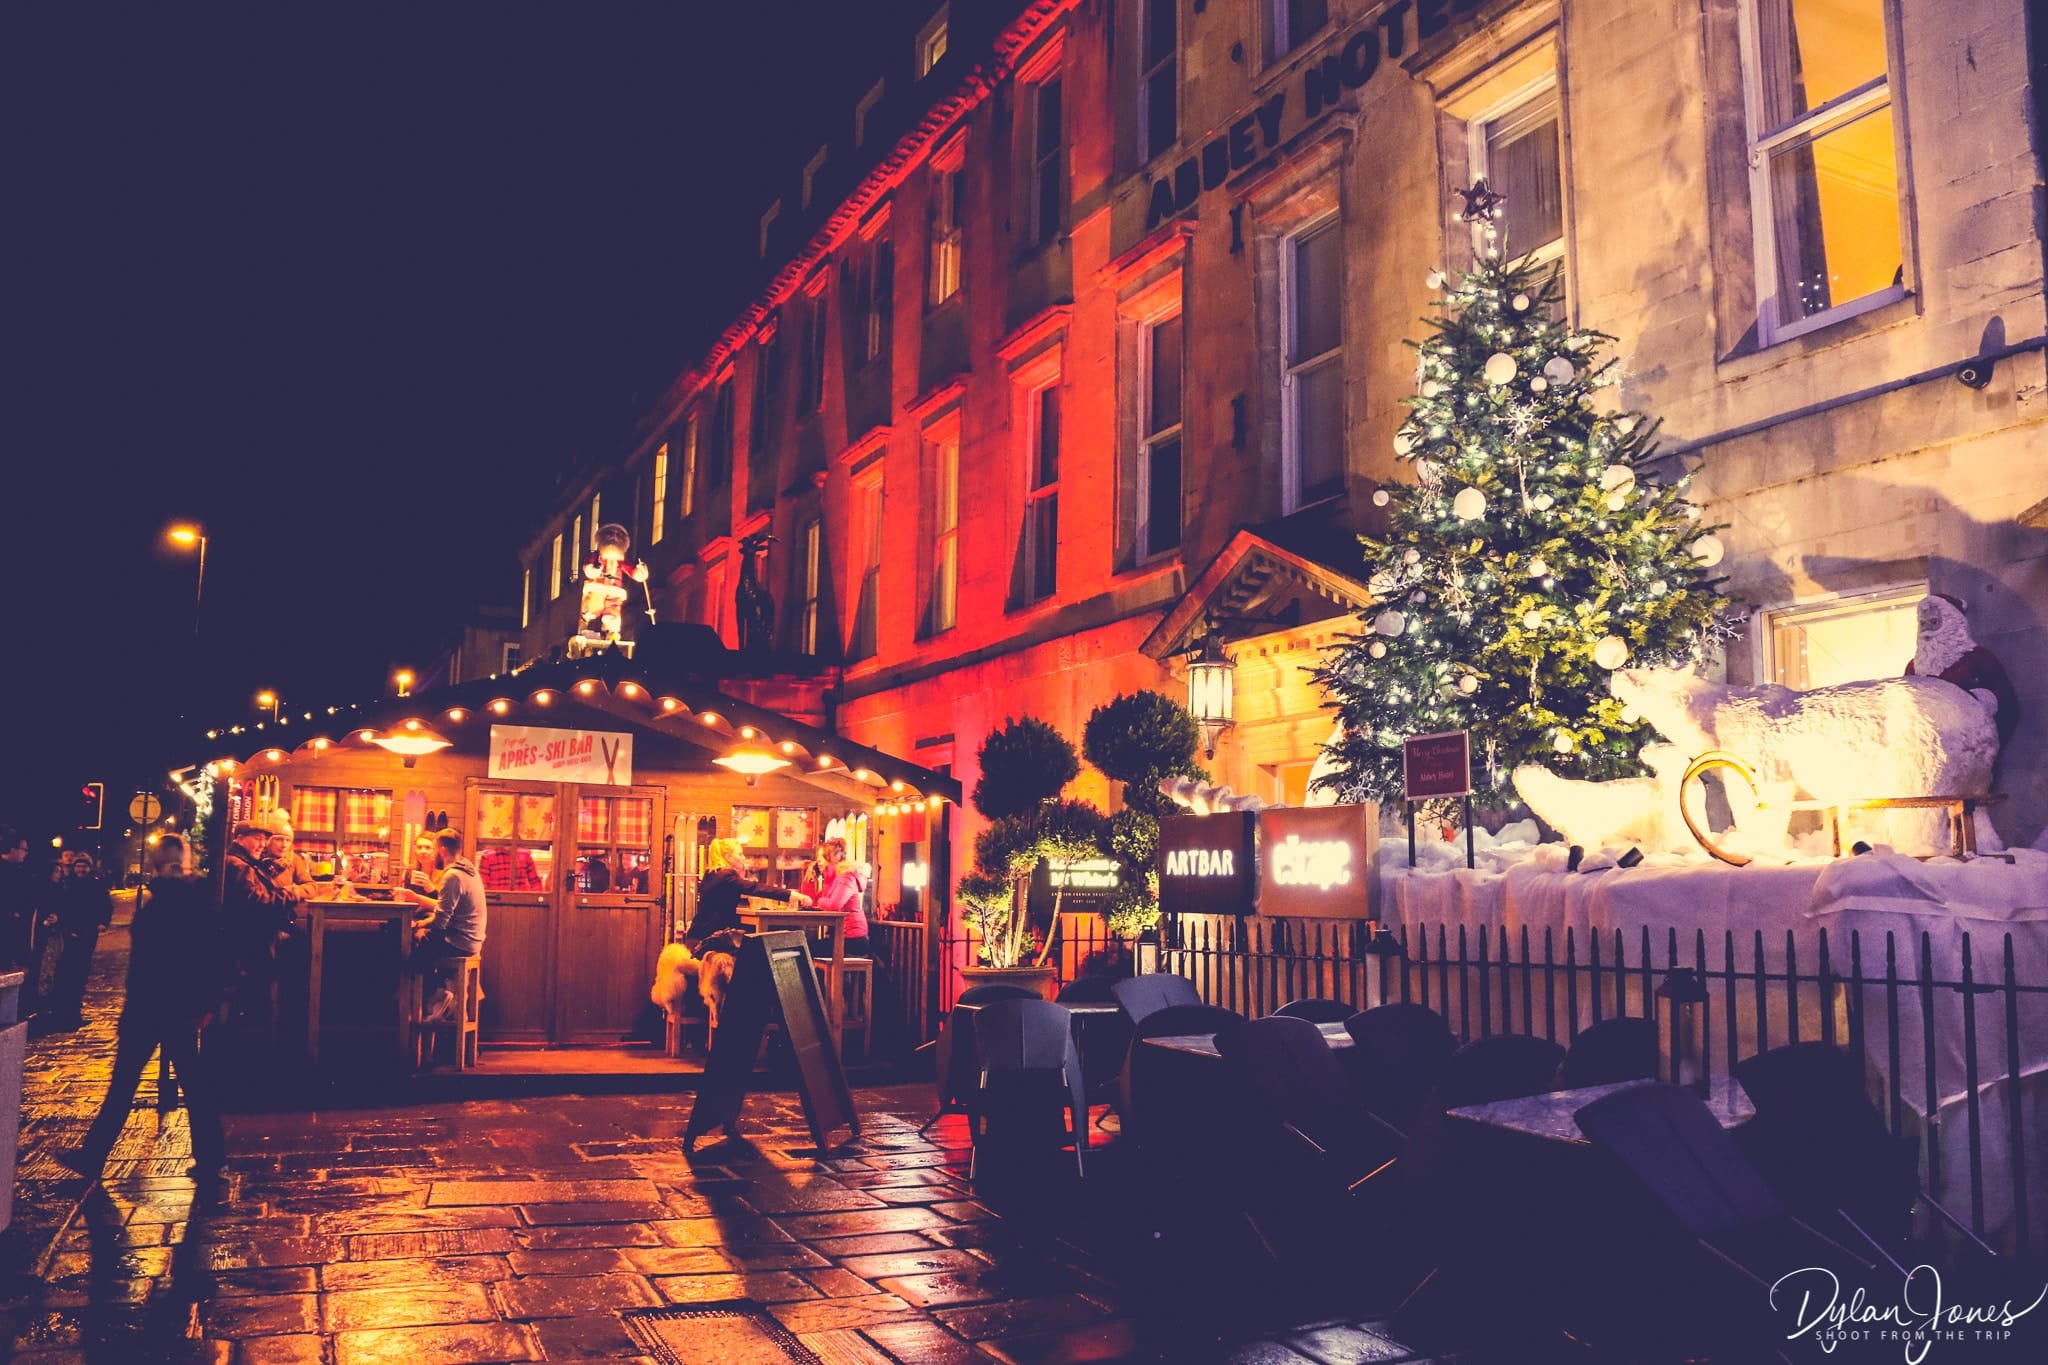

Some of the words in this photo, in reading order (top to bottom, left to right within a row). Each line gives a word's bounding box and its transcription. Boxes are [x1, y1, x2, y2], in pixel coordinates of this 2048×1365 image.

[1147, 93, 1286, 229] ABBEY
[569, 735, 593, 757] BAR
[1166, 850, 1234, 877] ARTBAR
